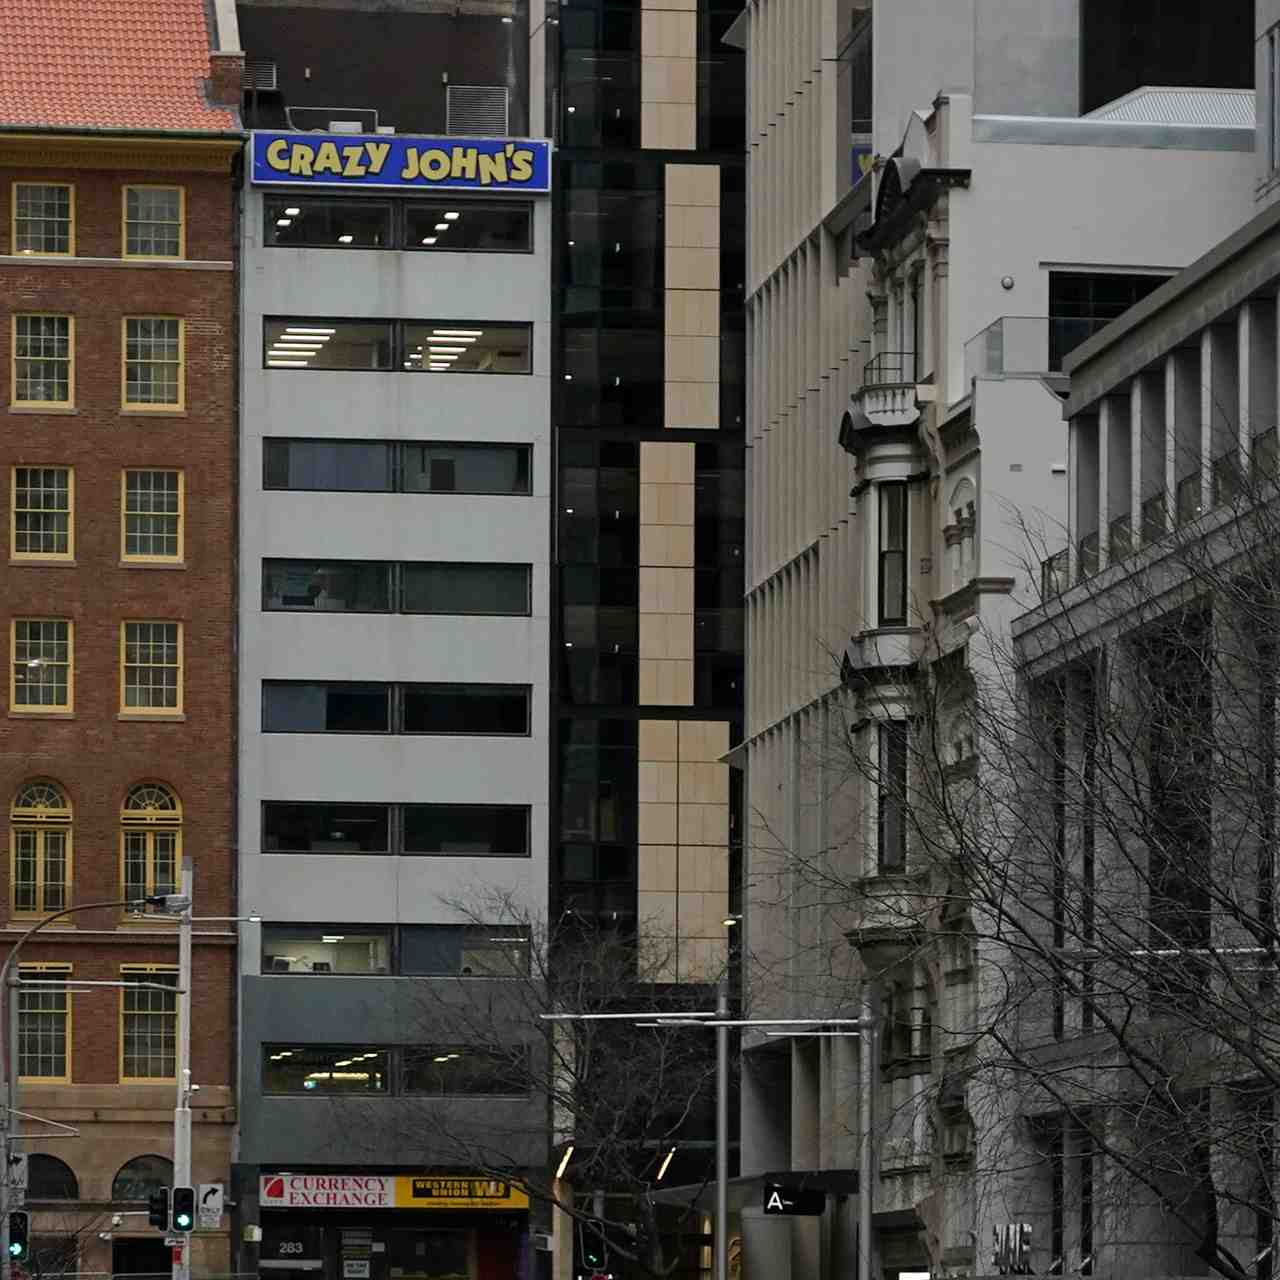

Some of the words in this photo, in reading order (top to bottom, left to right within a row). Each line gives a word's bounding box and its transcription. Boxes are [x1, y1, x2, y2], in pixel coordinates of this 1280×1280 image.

[266, 139, 391, 176] CRAZY
[400, 144, 534, 184] JOHN'S
[289, 1177, 386, 1192] CURRENCY
[416, 1181, 469, 1189] WESTERN
[289, 1192, 388, 1206] EXCHANGE
[431, 1188, 469, 1197] UNION
[279, 1240, 304, 1254] 283
